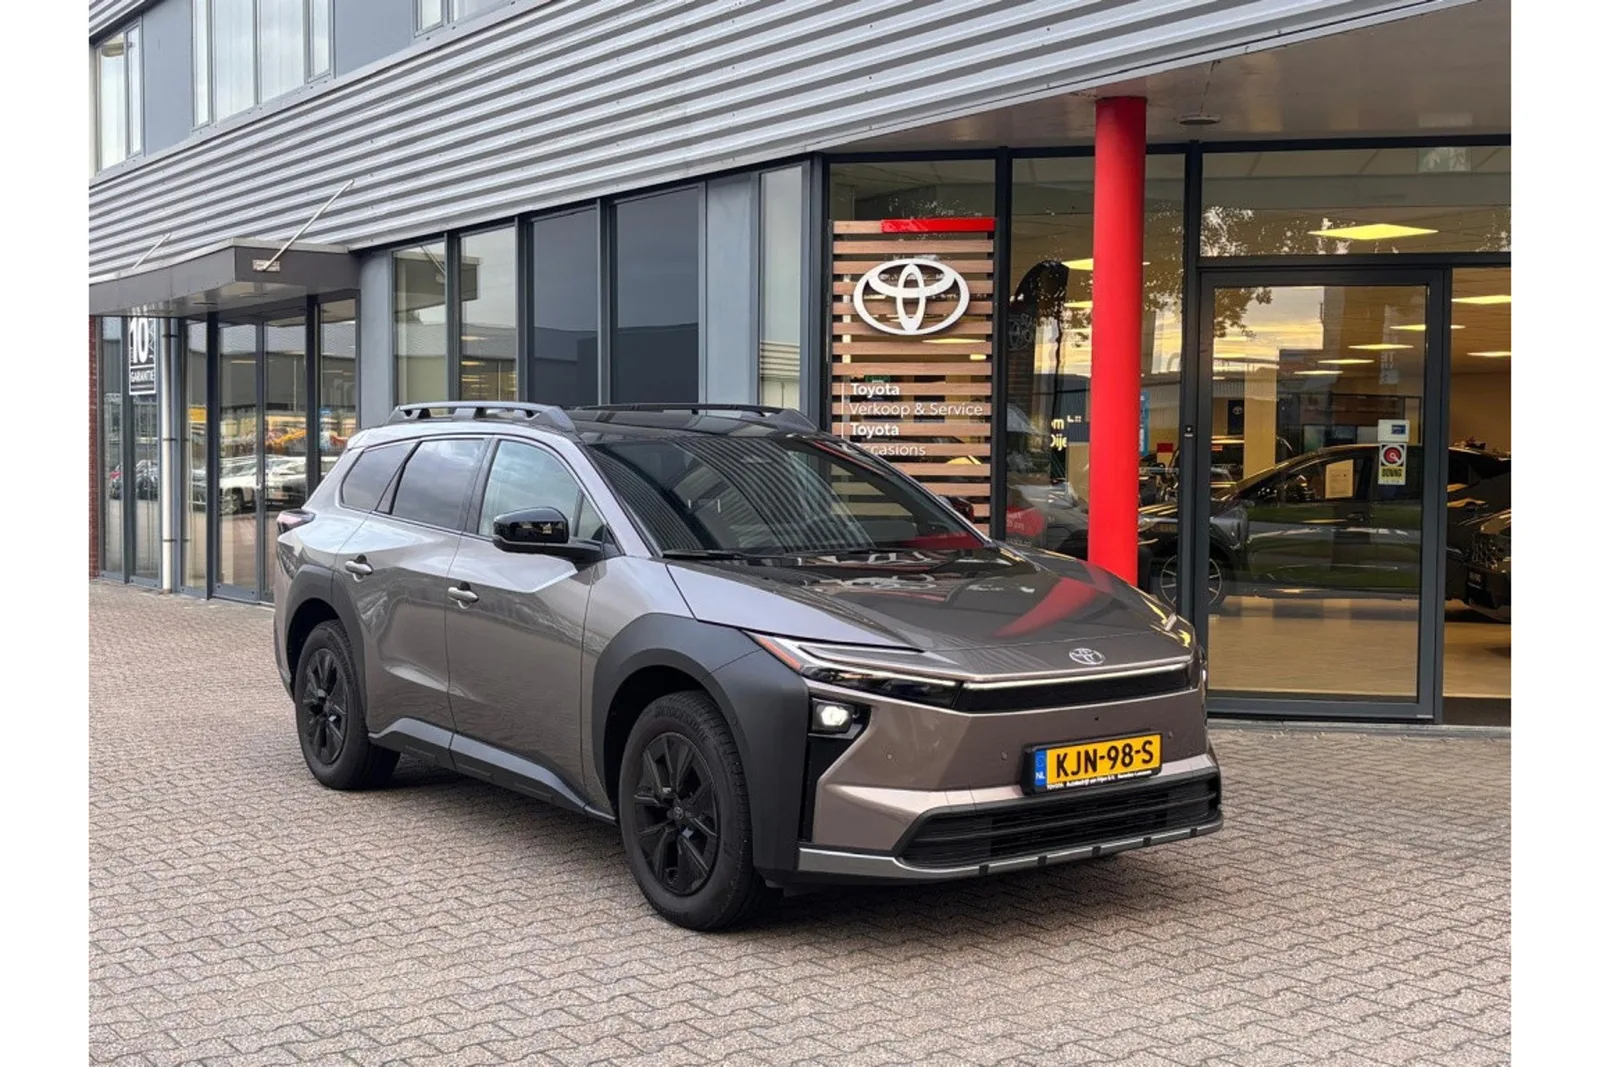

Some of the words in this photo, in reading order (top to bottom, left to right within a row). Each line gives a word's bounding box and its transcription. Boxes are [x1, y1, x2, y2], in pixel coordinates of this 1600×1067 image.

[130, 317, 149, 363] 10
[850, 383, 900, 398] Toyota
[849, 403, 910, 417] Verkoop
[914, 403, 925, 415] &
[930, 403, 983, 415] Service
[850, 423, 900, 438] Toyota
[857, 443, 926, 456] ccasions
[1056, 740, 1154, 778] KJN-98-S
[1036, 771, 1046, 779] NL
